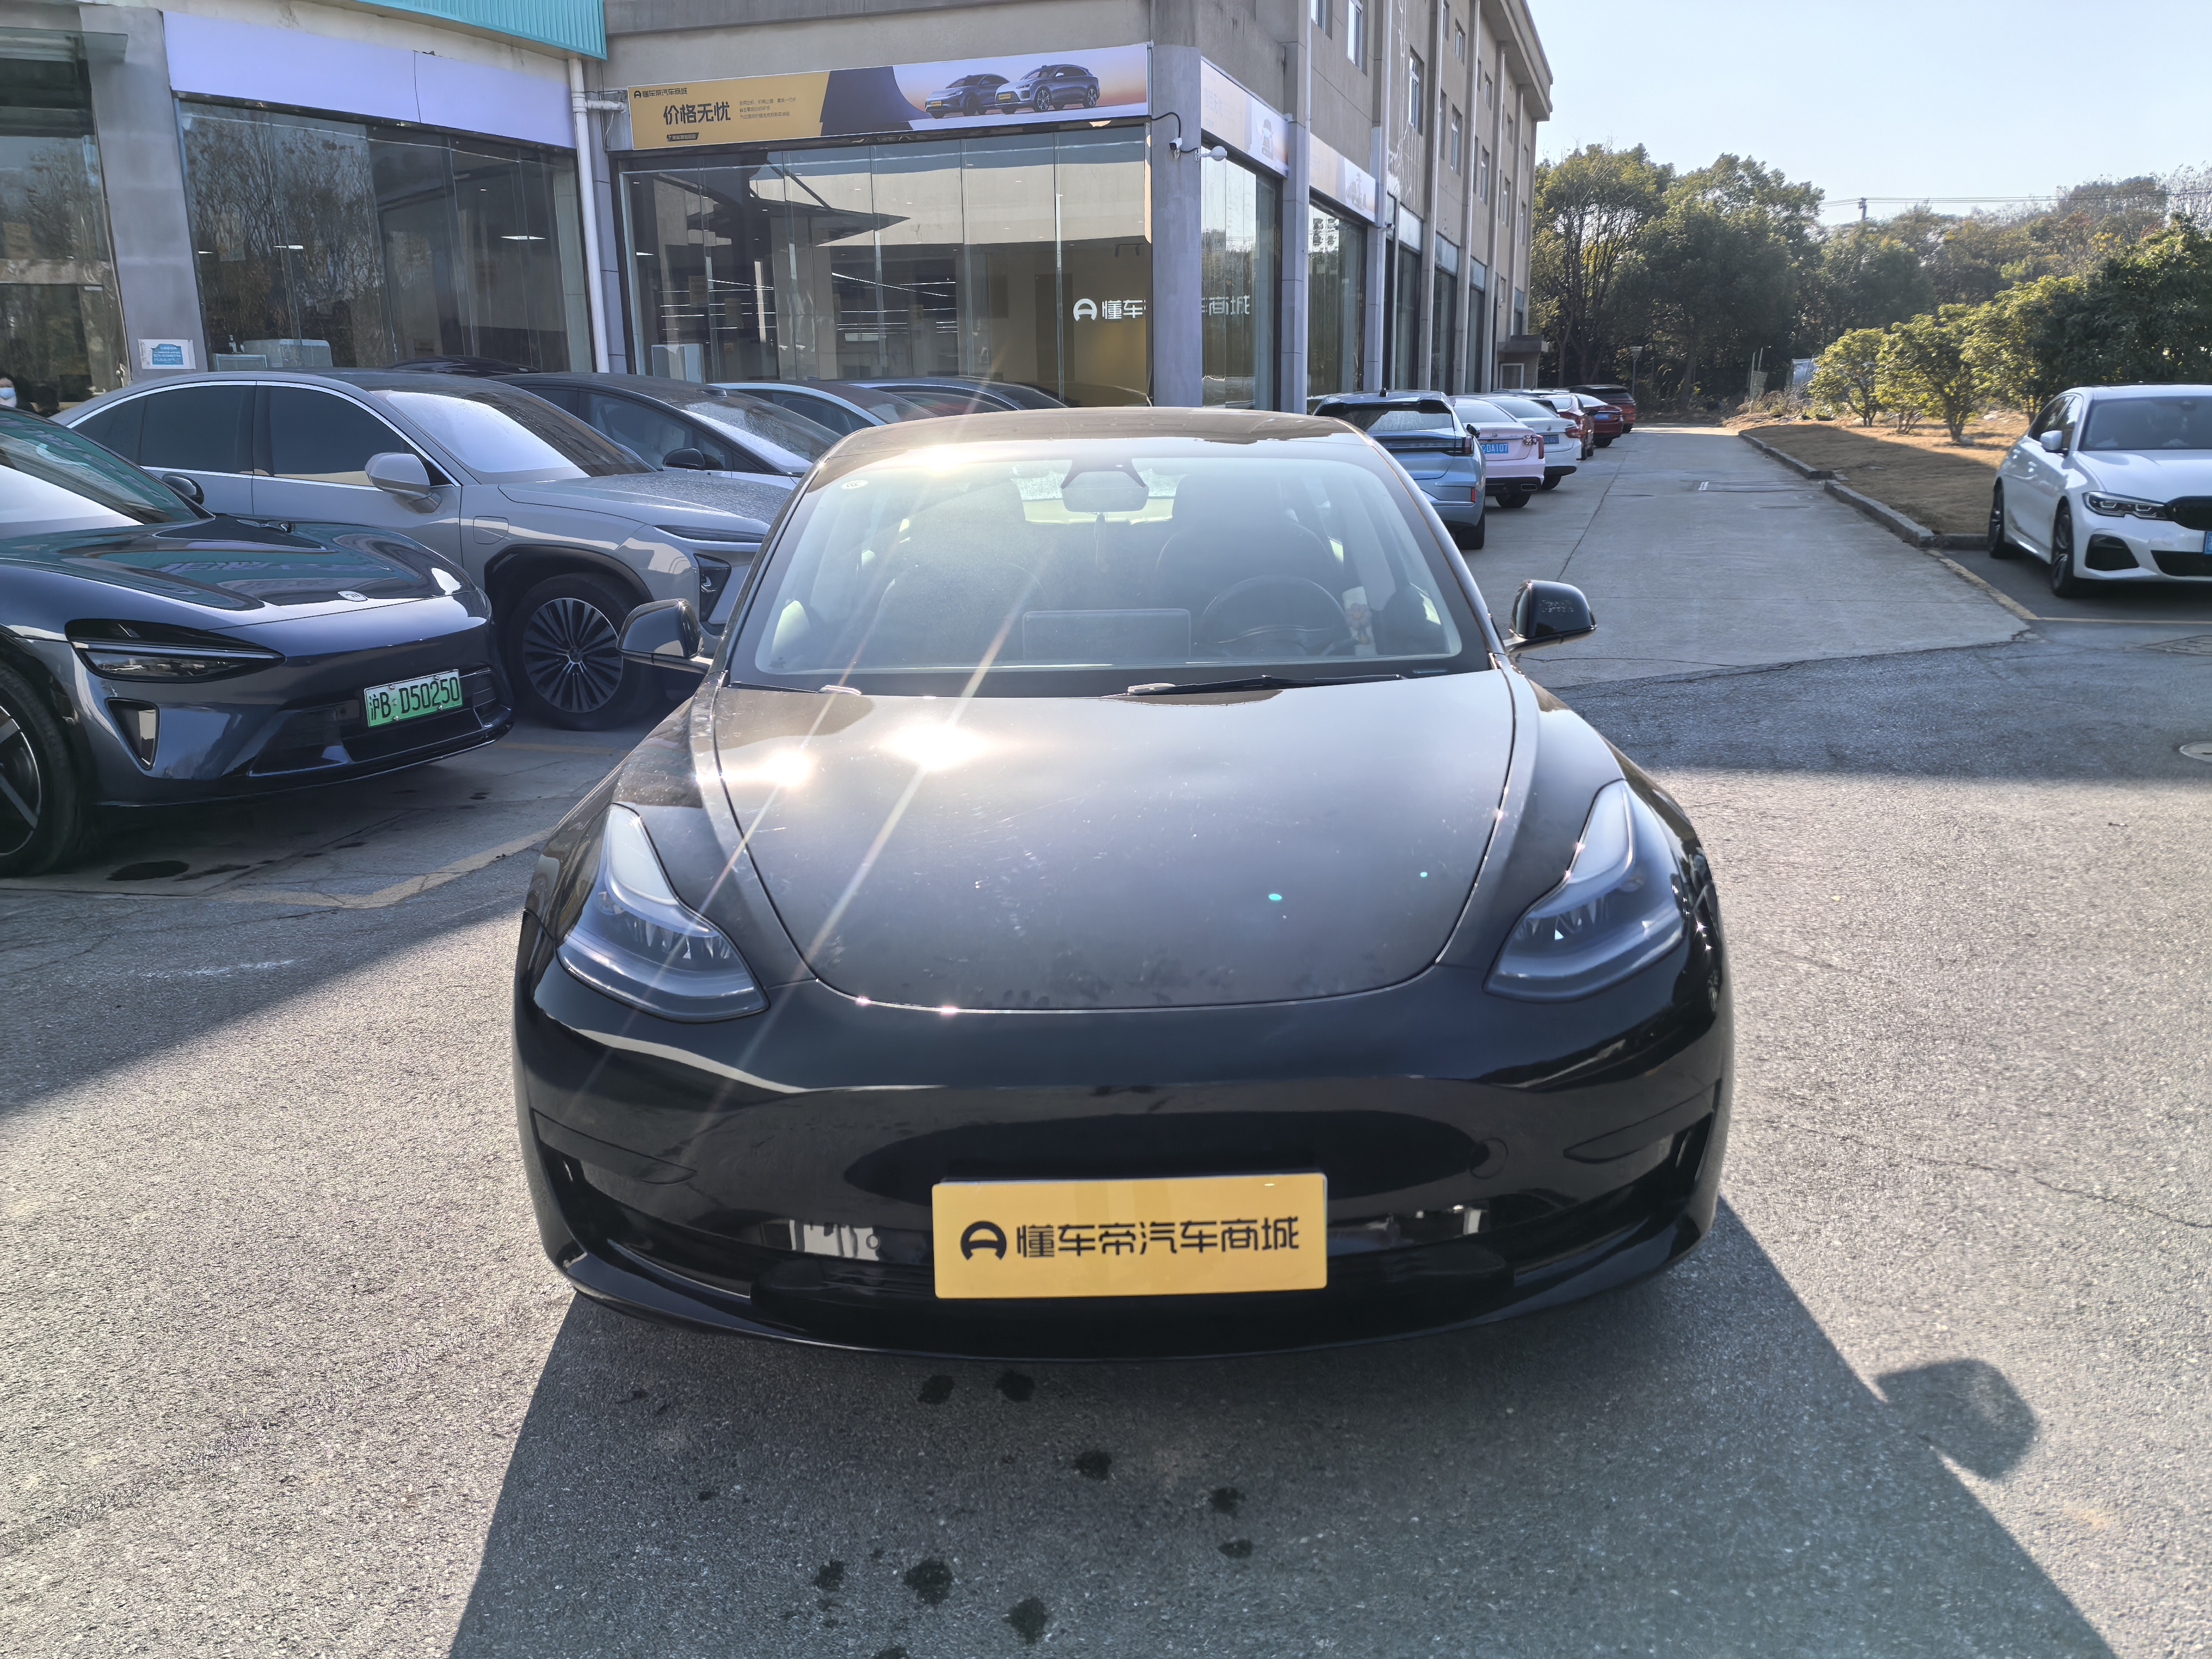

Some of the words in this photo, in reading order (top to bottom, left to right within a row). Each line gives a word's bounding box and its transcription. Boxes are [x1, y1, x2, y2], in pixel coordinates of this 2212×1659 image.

[663, 102, 731, 125] 价格无忧
[1102, 299, 1146, 320] 懂车
[1016, 1216, 1299, 1258] 懂车帝汽车商城
